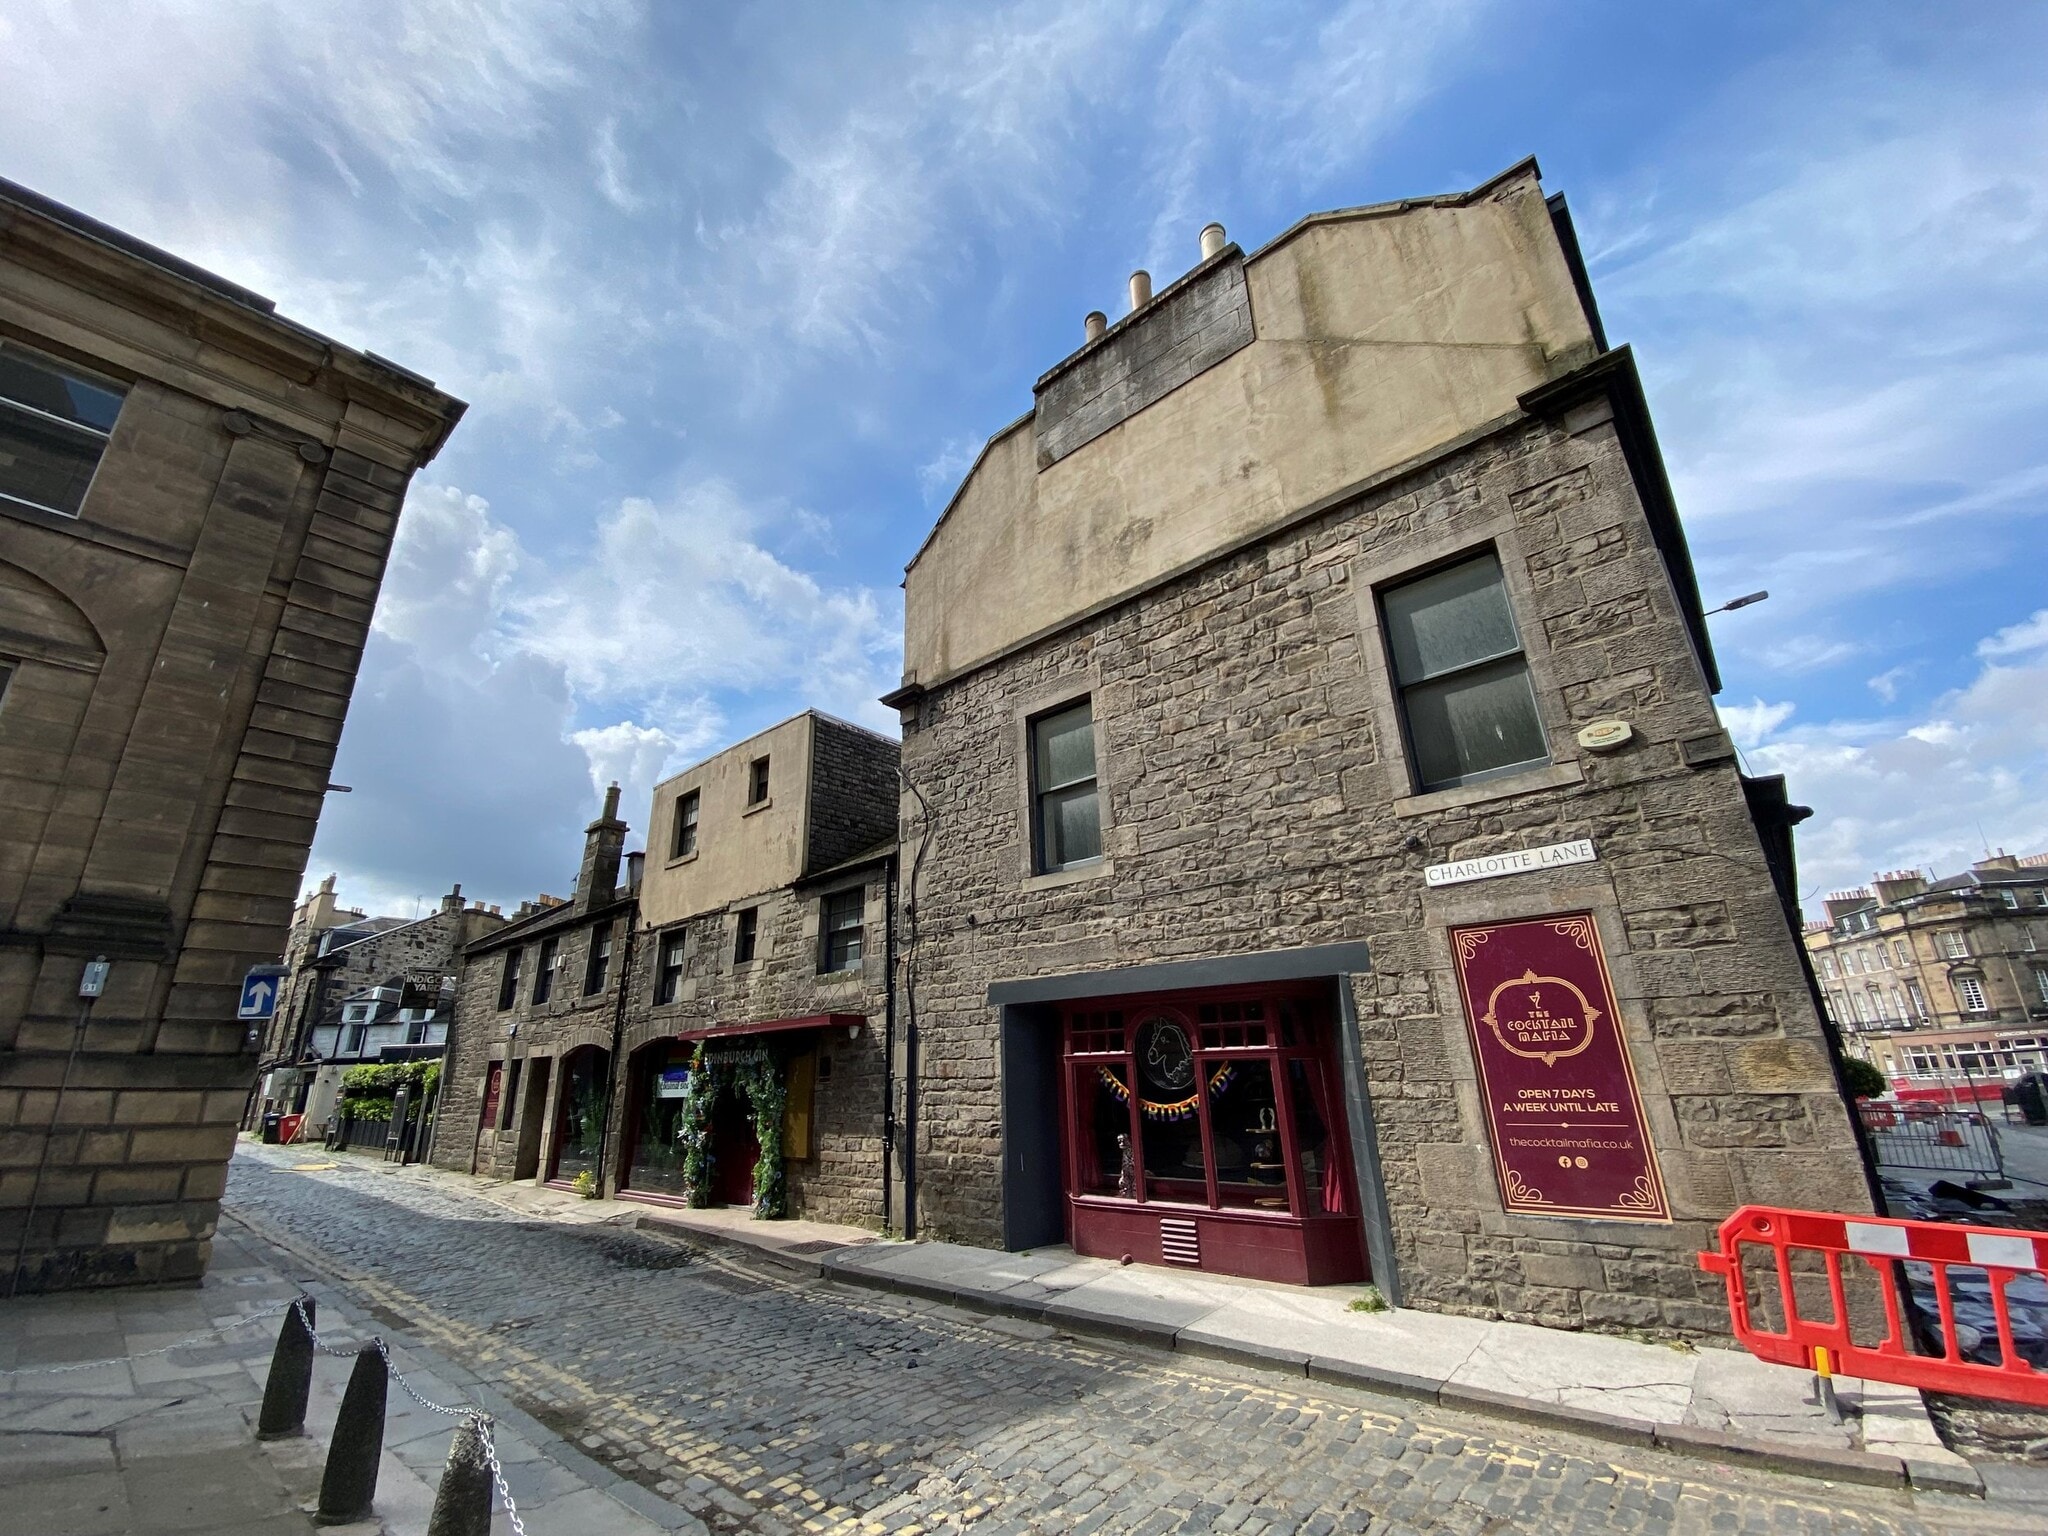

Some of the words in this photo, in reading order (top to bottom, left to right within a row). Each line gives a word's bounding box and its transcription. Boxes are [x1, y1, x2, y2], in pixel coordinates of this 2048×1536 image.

[1428, 853, 1531, 881] CHARLOTTE
[1540, 843, 1591, 864] LANE
[406, 974, 443, 984] INDIGO
[414, 983, 441, 991] YARD
[1507, 1018, 1577, 1030] COCKTAIL
[1518, 1030, 1570, 1042] MAFIA
[1518, 1089, 1551, 1099] OPEN
[1552, 1089, 1560, 1099] 7
[1561, 1089, 1596, 1099] DAYS
[1503, 1102, 1513, 1112] A
[1513, 1102, 1549, 1112] WEEK
[1550, 1103, 1586, 1113] UNTIL
[1587, 1102, 1620, 1113] LATE
[1509, 1138, 1634, 1149] thecocktailmafia.co.uk
